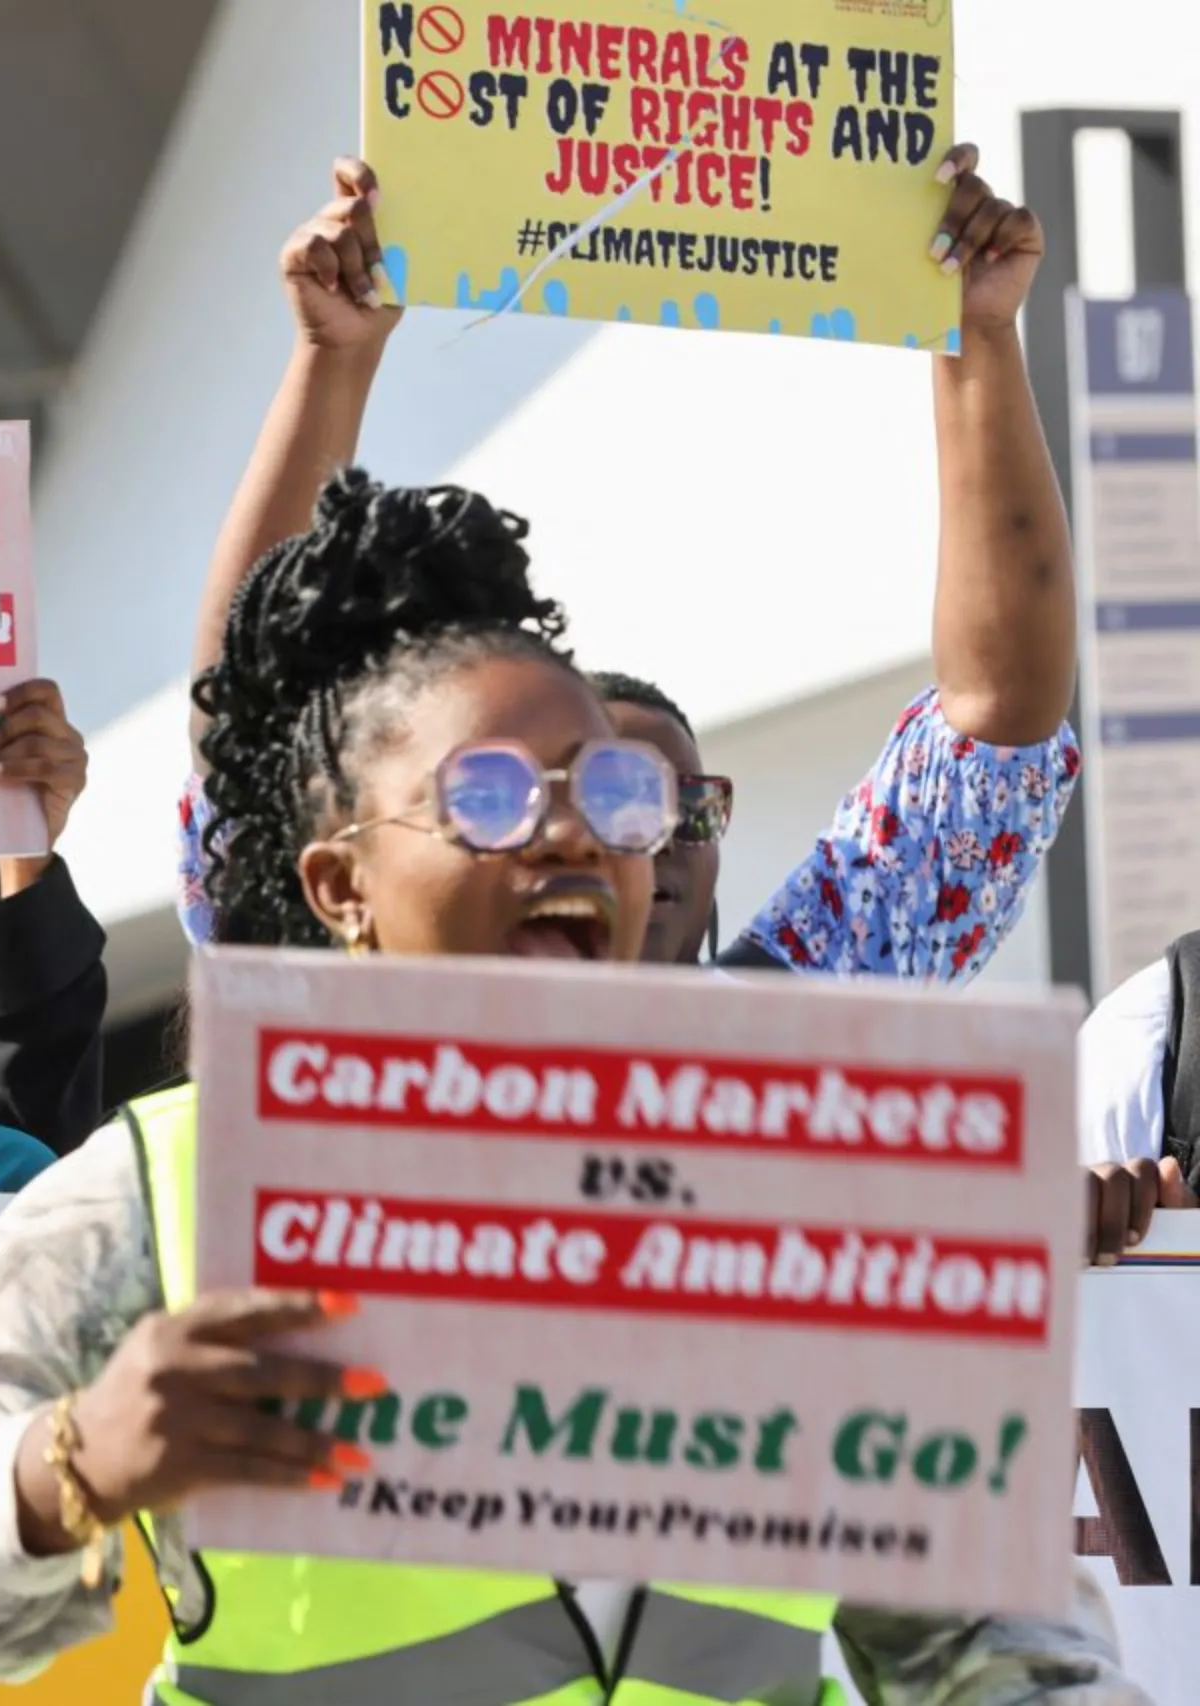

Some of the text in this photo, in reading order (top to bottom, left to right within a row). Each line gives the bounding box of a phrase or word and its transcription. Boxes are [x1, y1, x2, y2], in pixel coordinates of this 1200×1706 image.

[487, 15, 748, 91] MINERALS
[768, 41, 829, 98] AT
[847, 47, 940, 109] THE
[547, 79, 610, 136] OF
[631, 86, 813, 156] RIGHTS
[832, 105, 935, 166] AND
[546, 138, 772, 213] JUSTICE!
[516, 218, 840, 282] #CLIMATEJUSTICE
[266, 1039, 1009, 1156] Carbon Markets
[579, 1153, 697, 1208] vs.
[258, 1199, 1048, 1322] Climate Ambition
[499, 1382, 799, 1477] Must
[831, 1406, 1028, 1498] Go!
[338, 1476, 932, 1559] #KeepYourPromises
